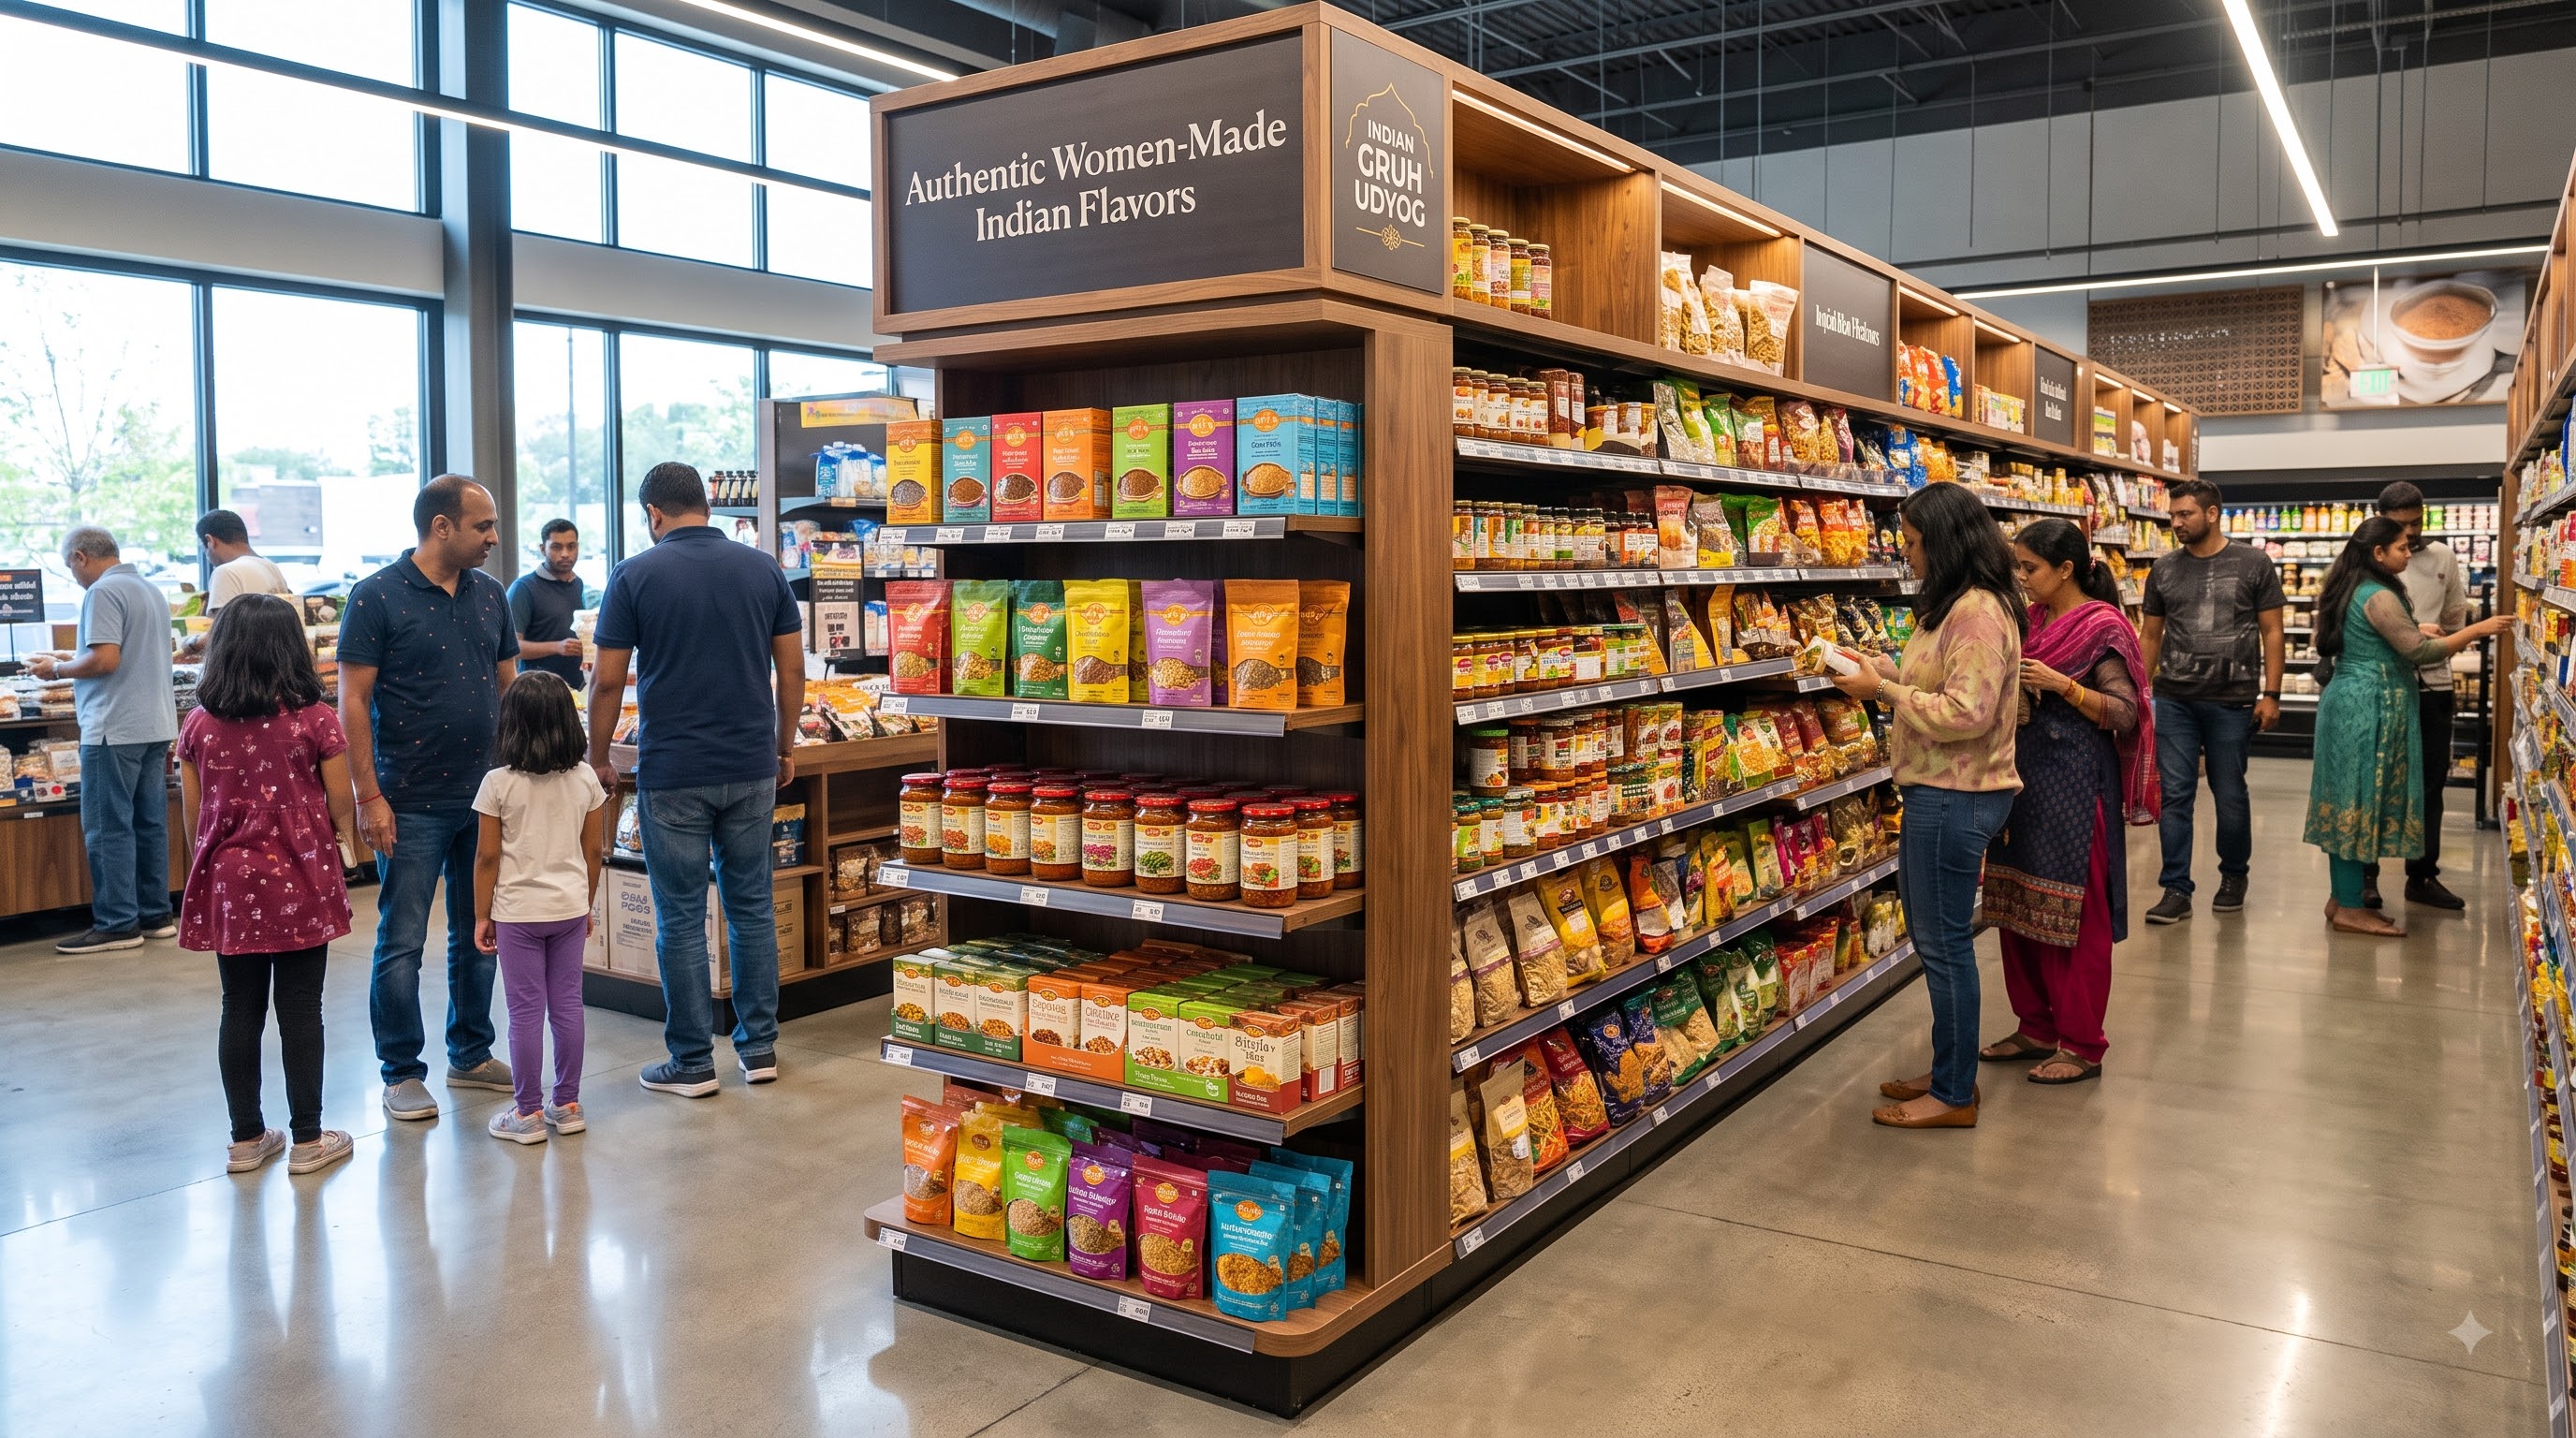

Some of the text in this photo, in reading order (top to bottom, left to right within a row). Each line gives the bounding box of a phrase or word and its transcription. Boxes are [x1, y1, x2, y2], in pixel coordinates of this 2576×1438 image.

[905, 109, 1286, 206] Authentic Women-Made
[1368, 119, 1414, 154] INDIAN
[1357, 143, 1422, 195] GRUH
[976, 186, 1196, 242] Indian Flavors
[1354, 179, 1426, 227] UDYOG
[2360, 371, 2391, 393] EXIT
